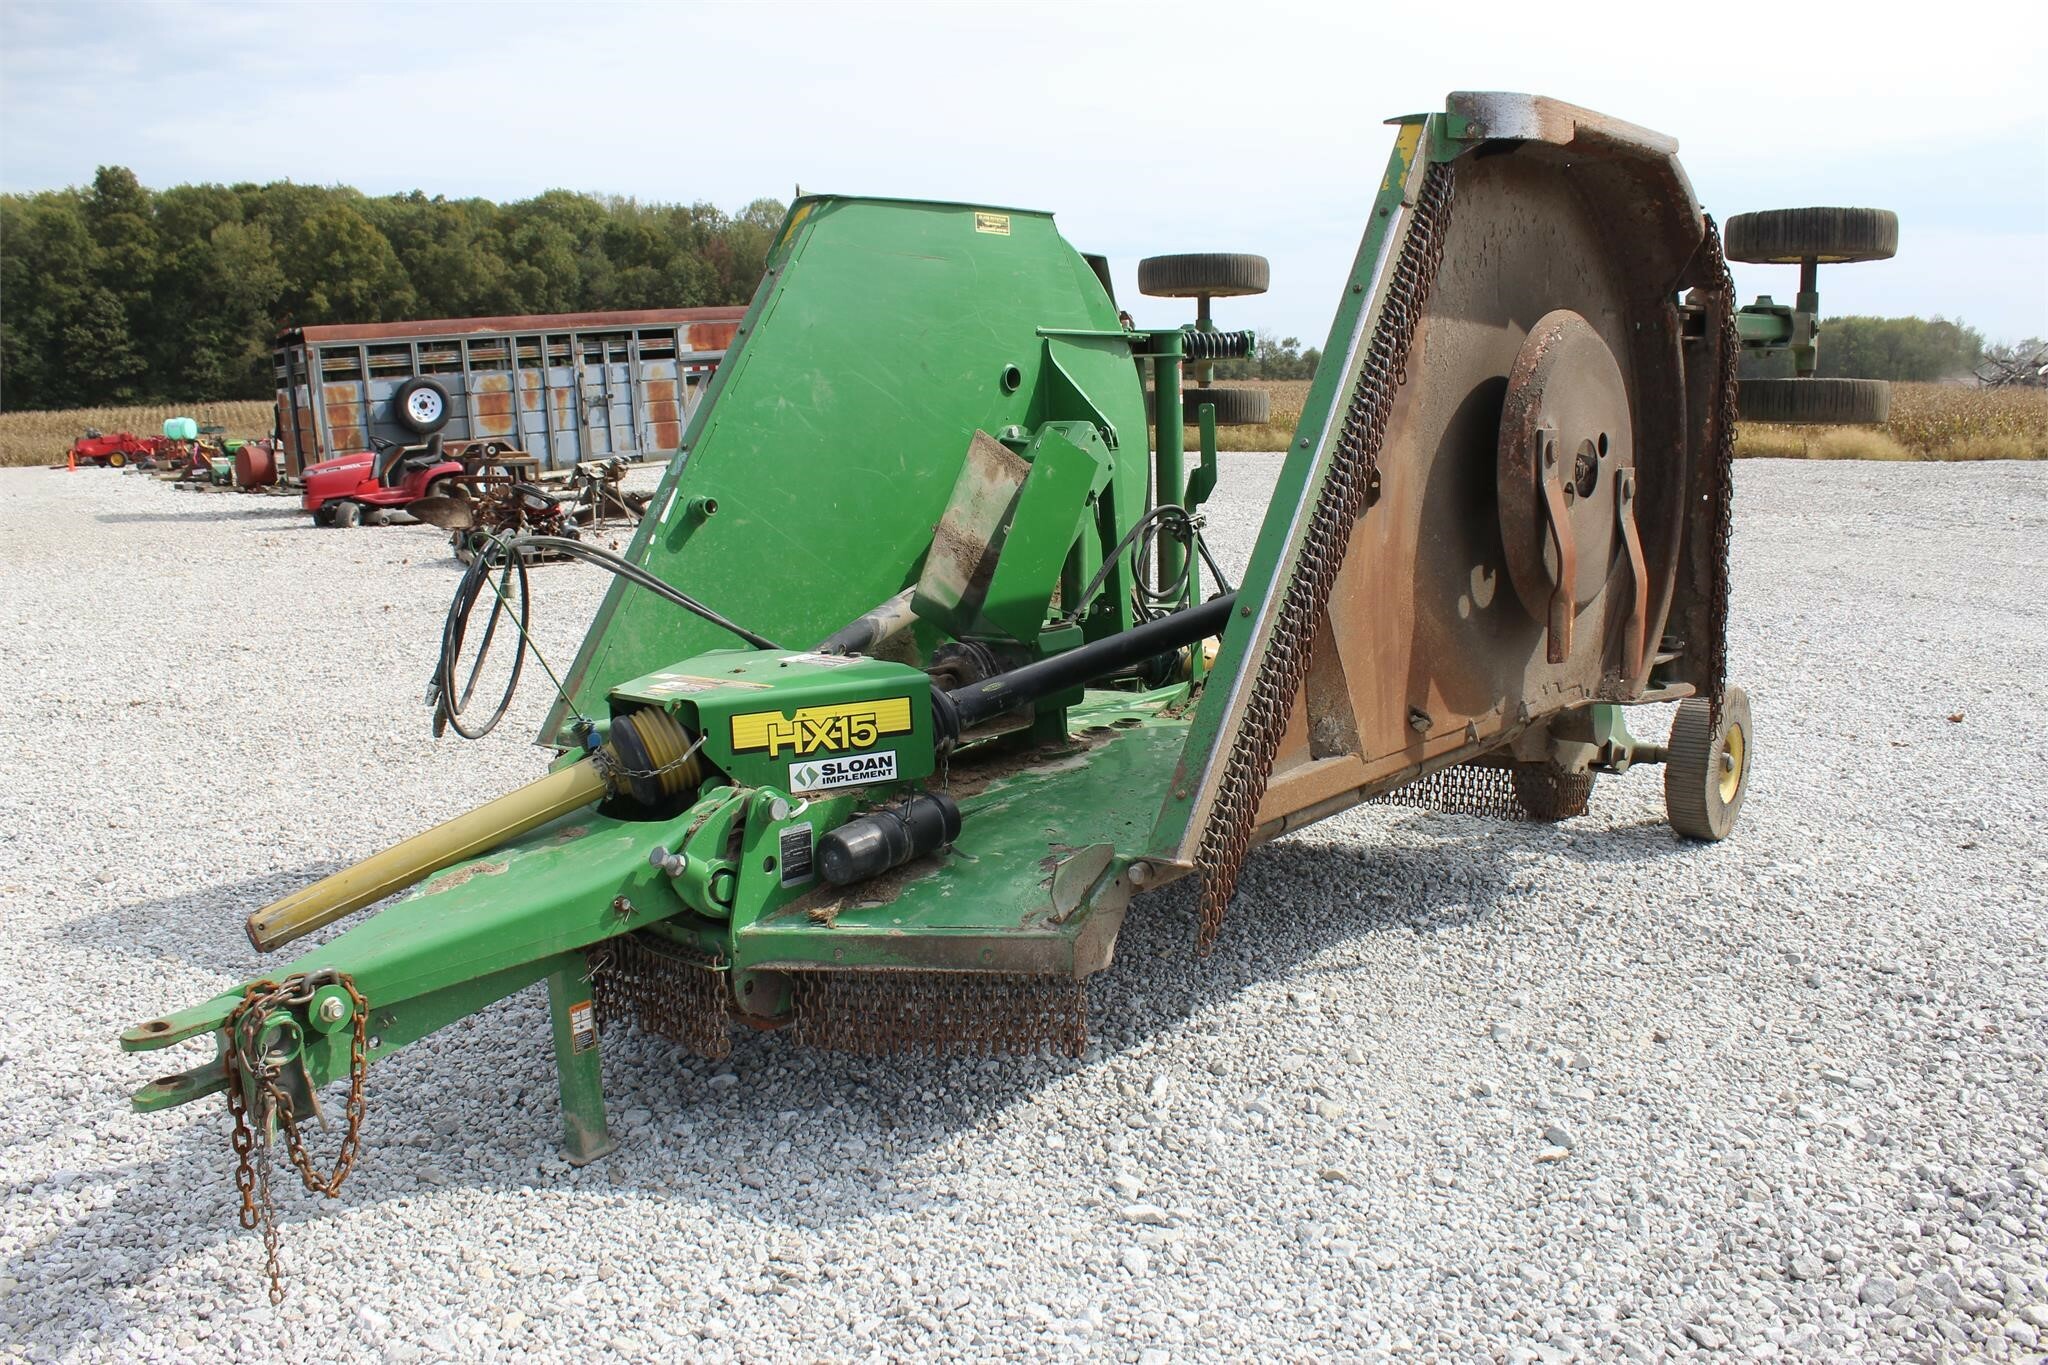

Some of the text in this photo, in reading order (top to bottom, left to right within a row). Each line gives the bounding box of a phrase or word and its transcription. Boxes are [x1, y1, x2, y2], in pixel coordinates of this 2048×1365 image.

[768, 712, 878, 758] HX15
[821, 755, 893, 776] SLOAN
[822, 768, 893, 785] IMPLEMENT
